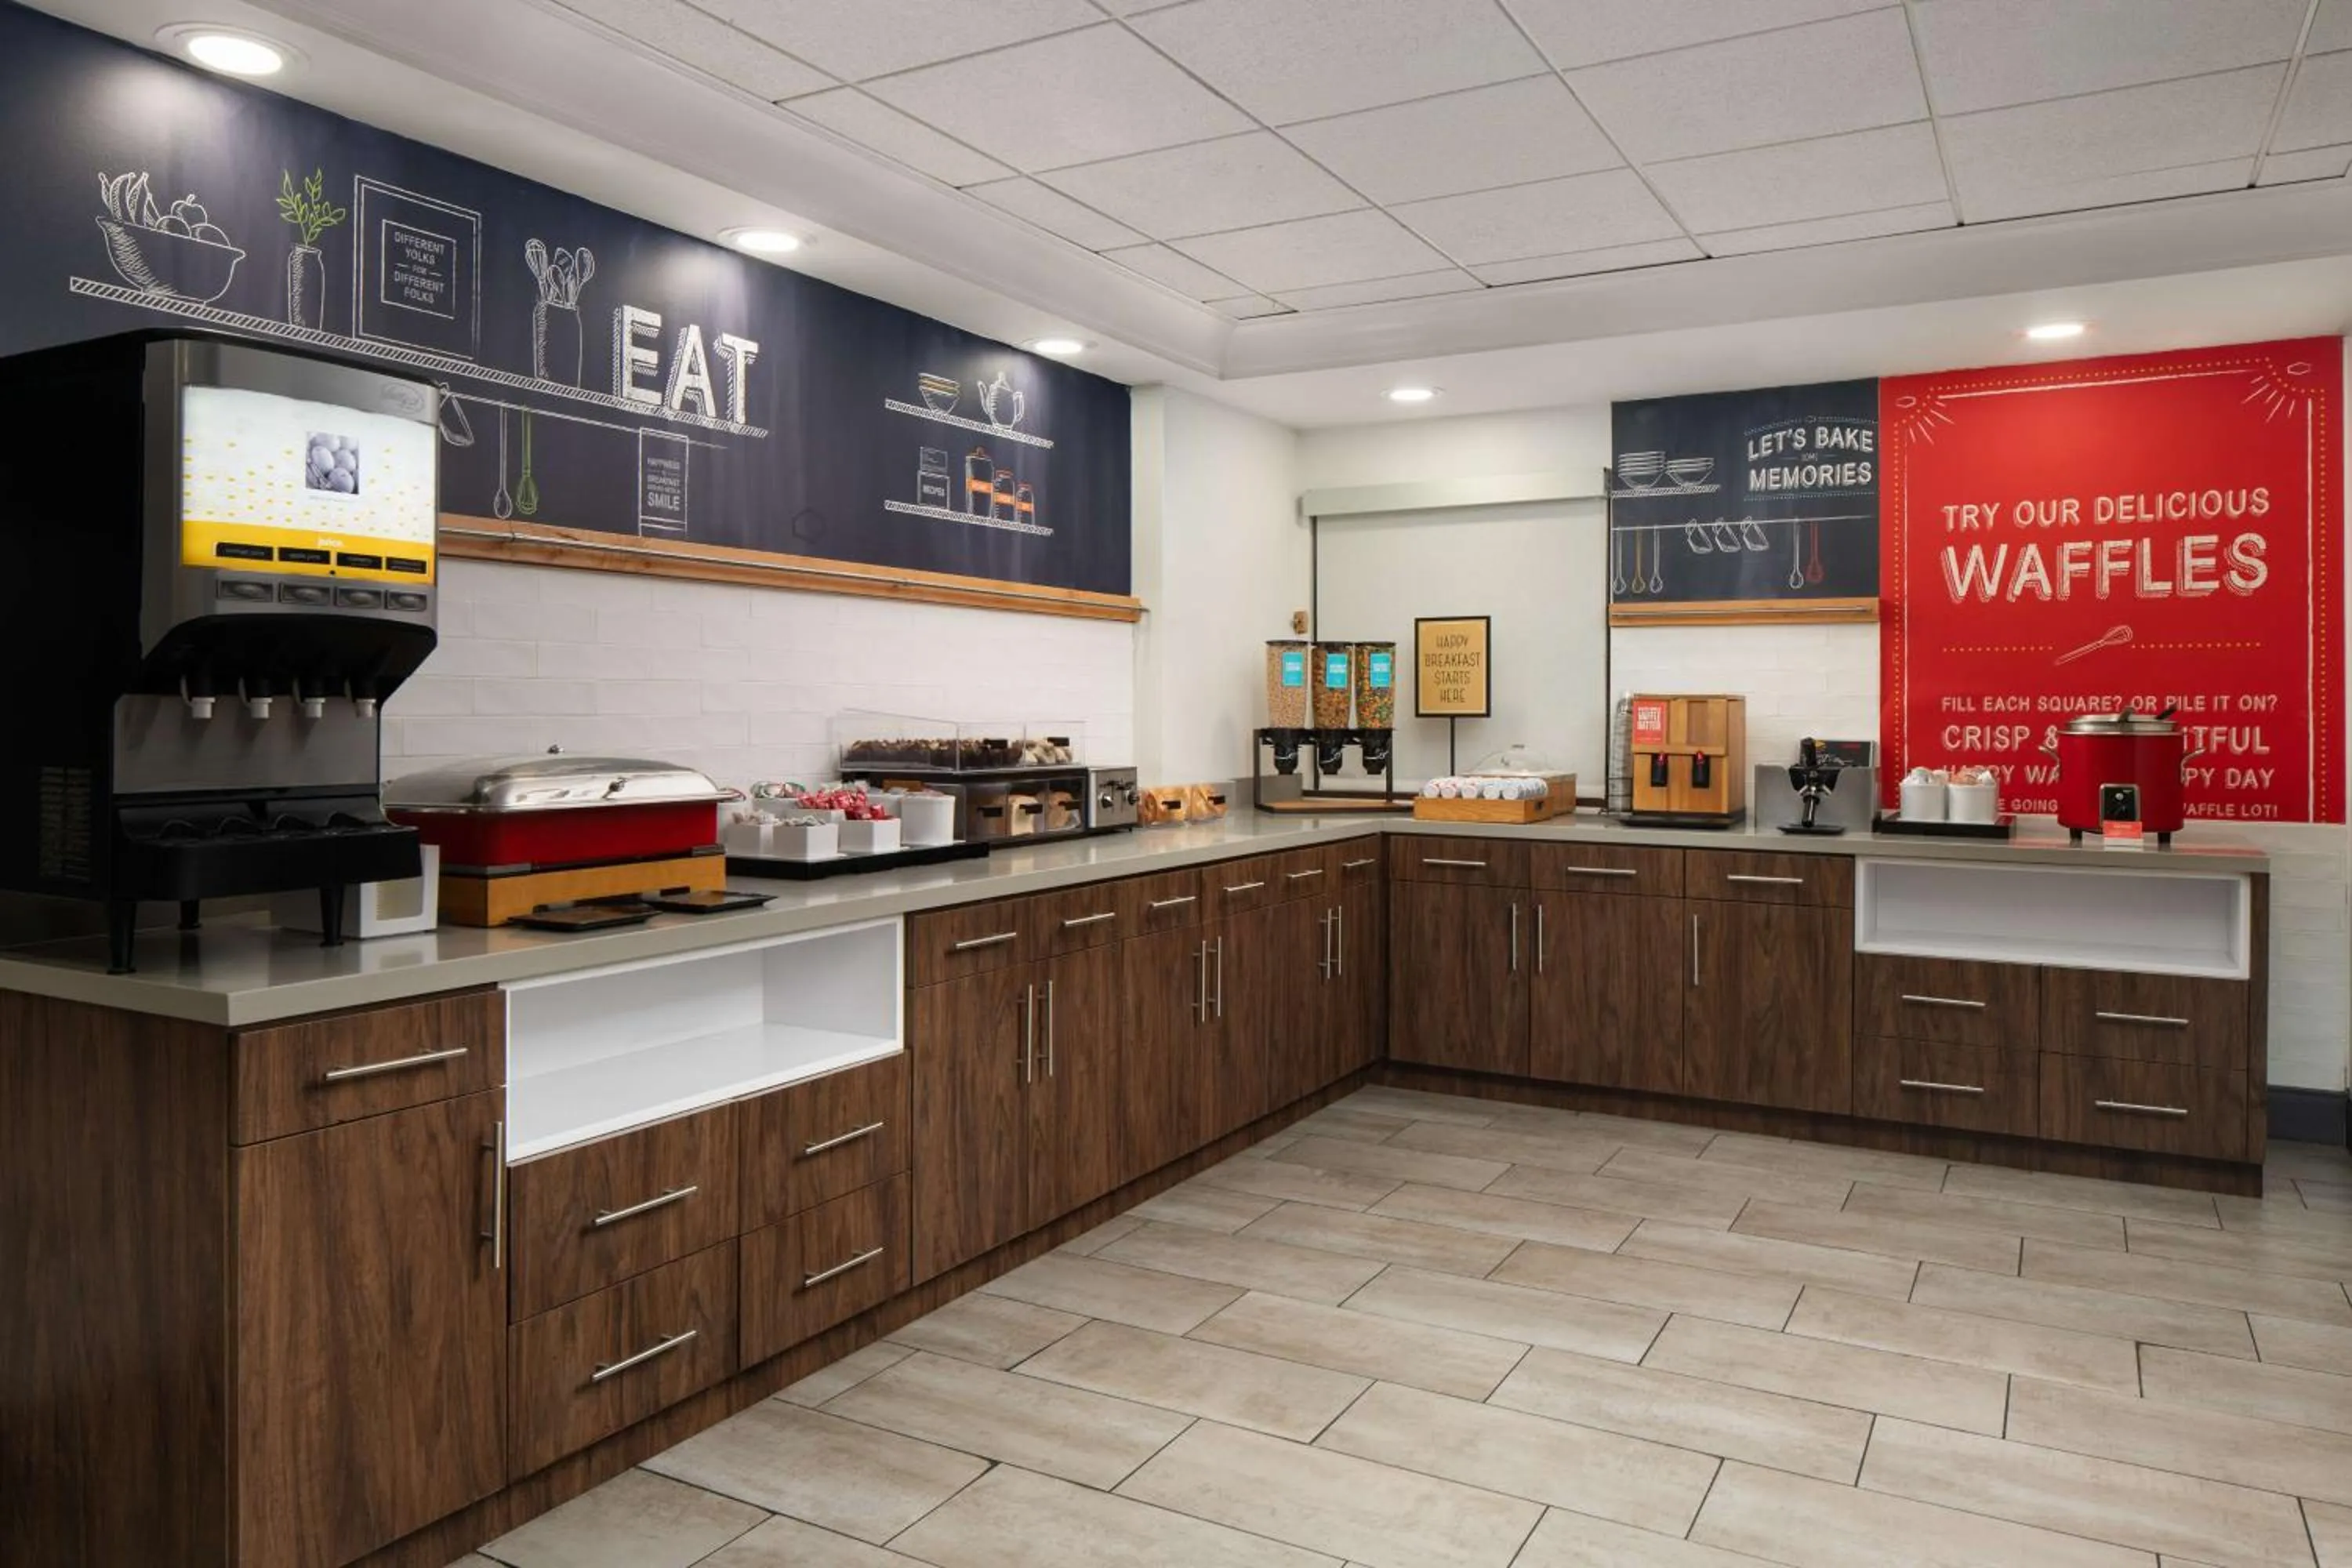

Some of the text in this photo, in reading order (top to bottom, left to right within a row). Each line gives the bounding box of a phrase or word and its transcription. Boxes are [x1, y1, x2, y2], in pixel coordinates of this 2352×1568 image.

[394, 231, 445, 255] DIFFERENT
[405, 248, 436, 265] YOLKS
[394, 270, 445, 293] DIFFERENT
[404, 286, 435, 304] FOLKS
[613, 304, 758, 424] EAT
[1748, 426, 1874, 462] LET'S BAKE
[1748, 462, 1872, 492] MEMORIES
[647, 492, 681, 512] SMILE
[1942, 488, 2270, 532] TRY OUR DELICIOUS
[1940, 532, 2269, 603] WAFFLES
[1436, 633, 1469, 648] HAPPY
[1425, 652, 1481, 669] BREAKFAST
[1433, 670, 1471, 687] STARTS
[1439, 688, 1466, 703] HERE
[1940, 694, 2278, 713] FILL EACH SQUARE? OR PILE IT ON?
[1941, 724, 2031, 751] CRISP
[2224, 768, 2274, 789] DAY
[2010, 798, 2058, 812] GOING
[2183, 802, 2235, 818] AFFLE
